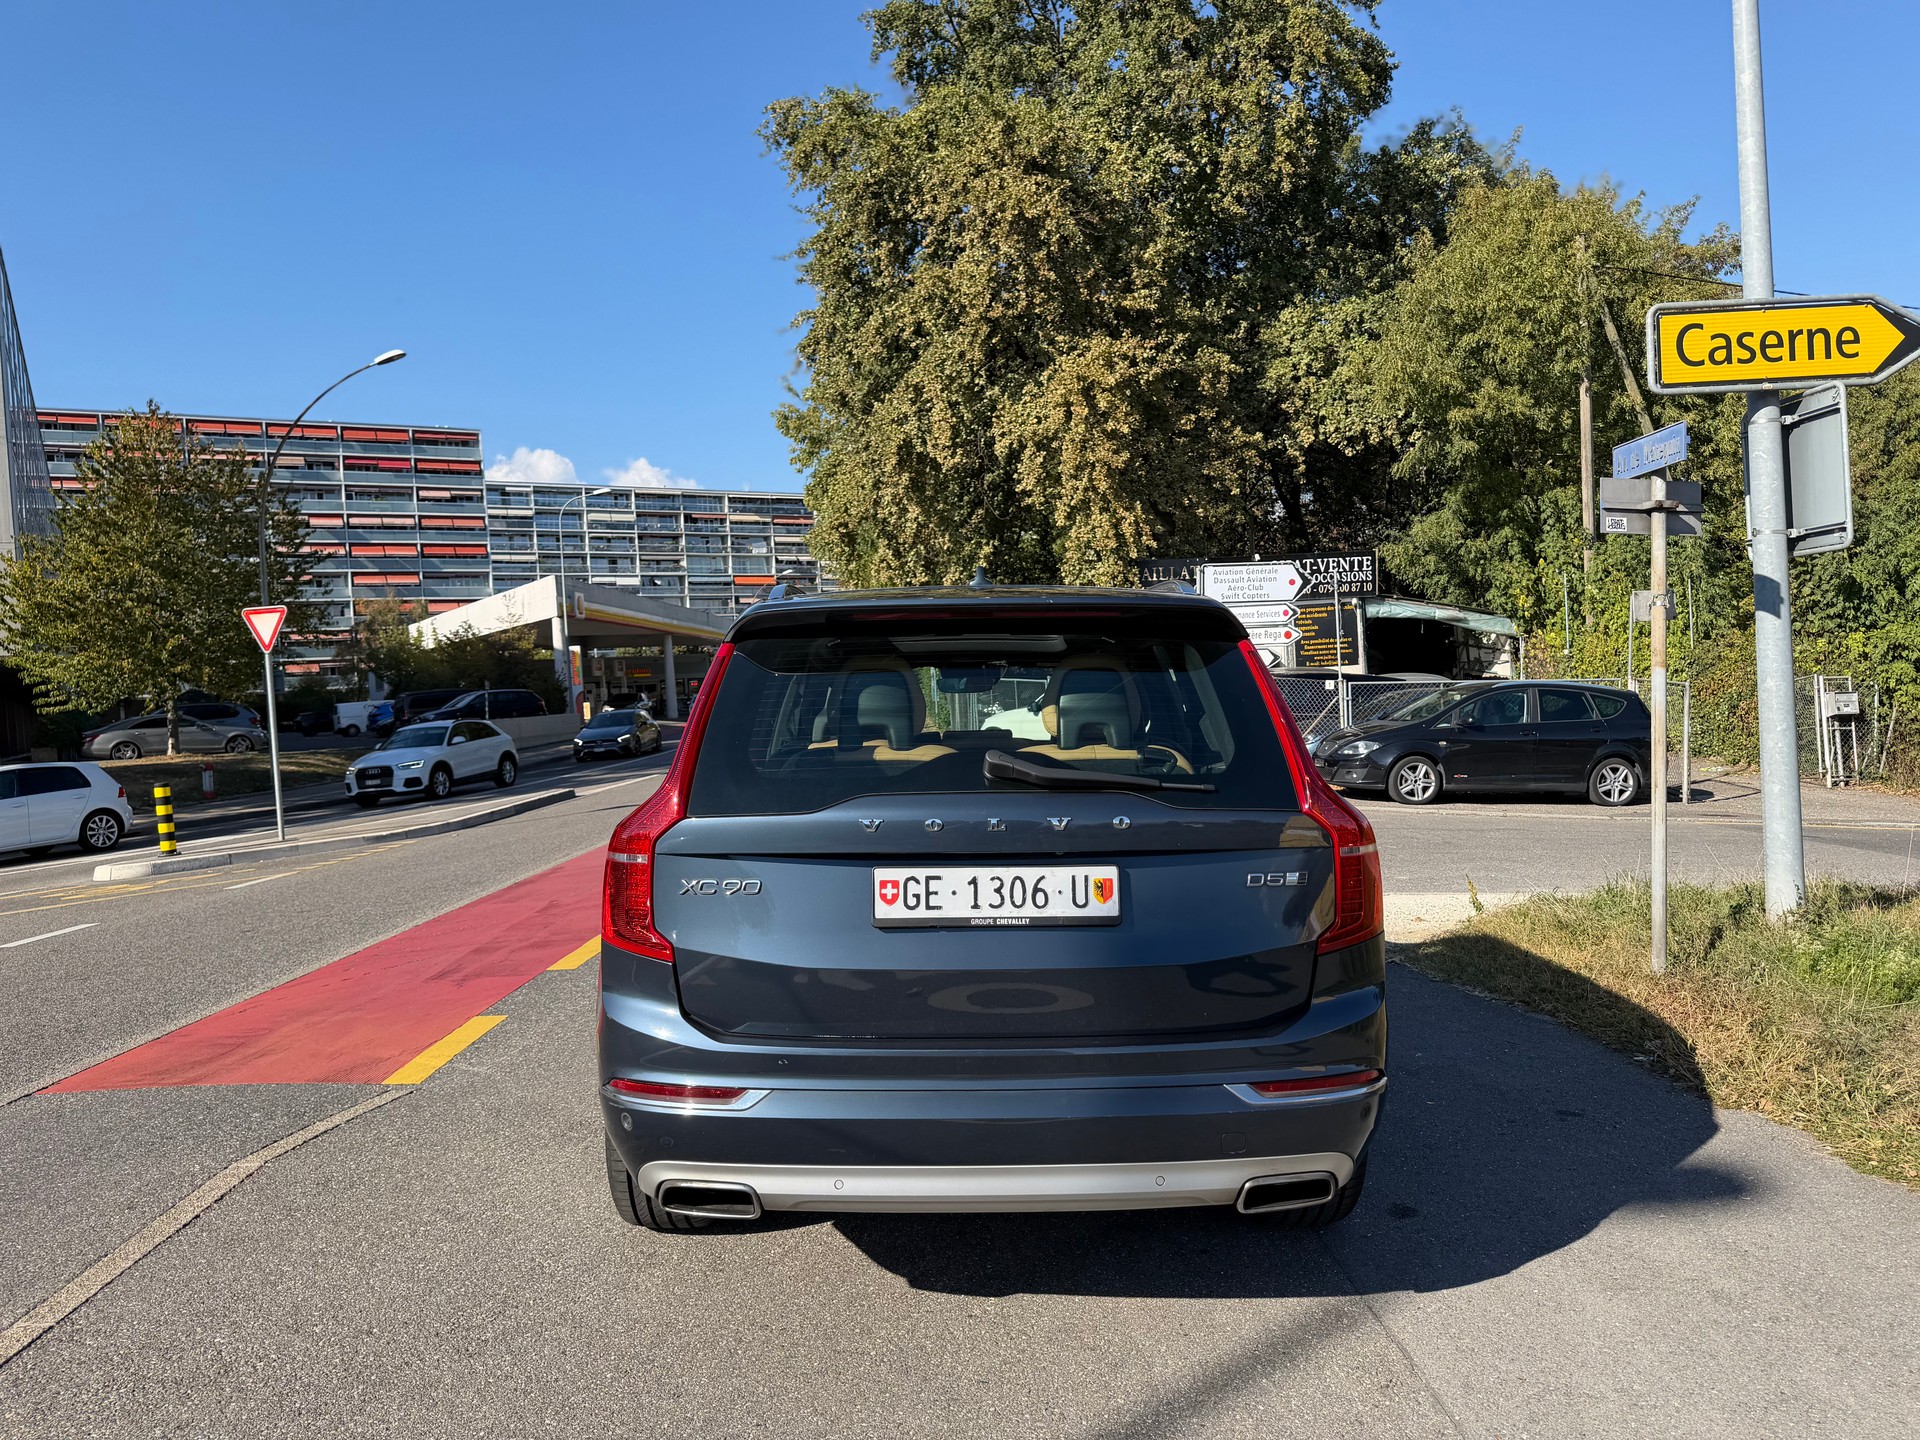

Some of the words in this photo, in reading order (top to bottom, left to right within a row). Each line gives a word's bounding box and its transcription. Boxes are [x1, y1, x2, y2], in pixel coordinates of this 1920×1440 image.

[1676, 322, 1861, 367] Caserne
[1303, 556, 1372, 573] T-VENTE
[1142, 565, 1200, 581] AILLAT
[1213, 568, 1243, 576] Aviation
[1246, 567, 1278, 575] Générale
[1213, 576, 1245, 584] Dassault
[1351, 583, 1360, 591] 87
[1363, 582, 1372, 591] 10
[1221, 592, 1240, 600] Swift
[1242, 592, 1270, 601] Copters
[1256, 610, 1281, 618] Services
[1264, 630, 1281, 641] Rega
[859, 815, 1132, 833] VOLVO
[902, 875, 943, 910] GE
[967, 875, 1049, 910] 1306
[1071, 874, 1089, 909] U
